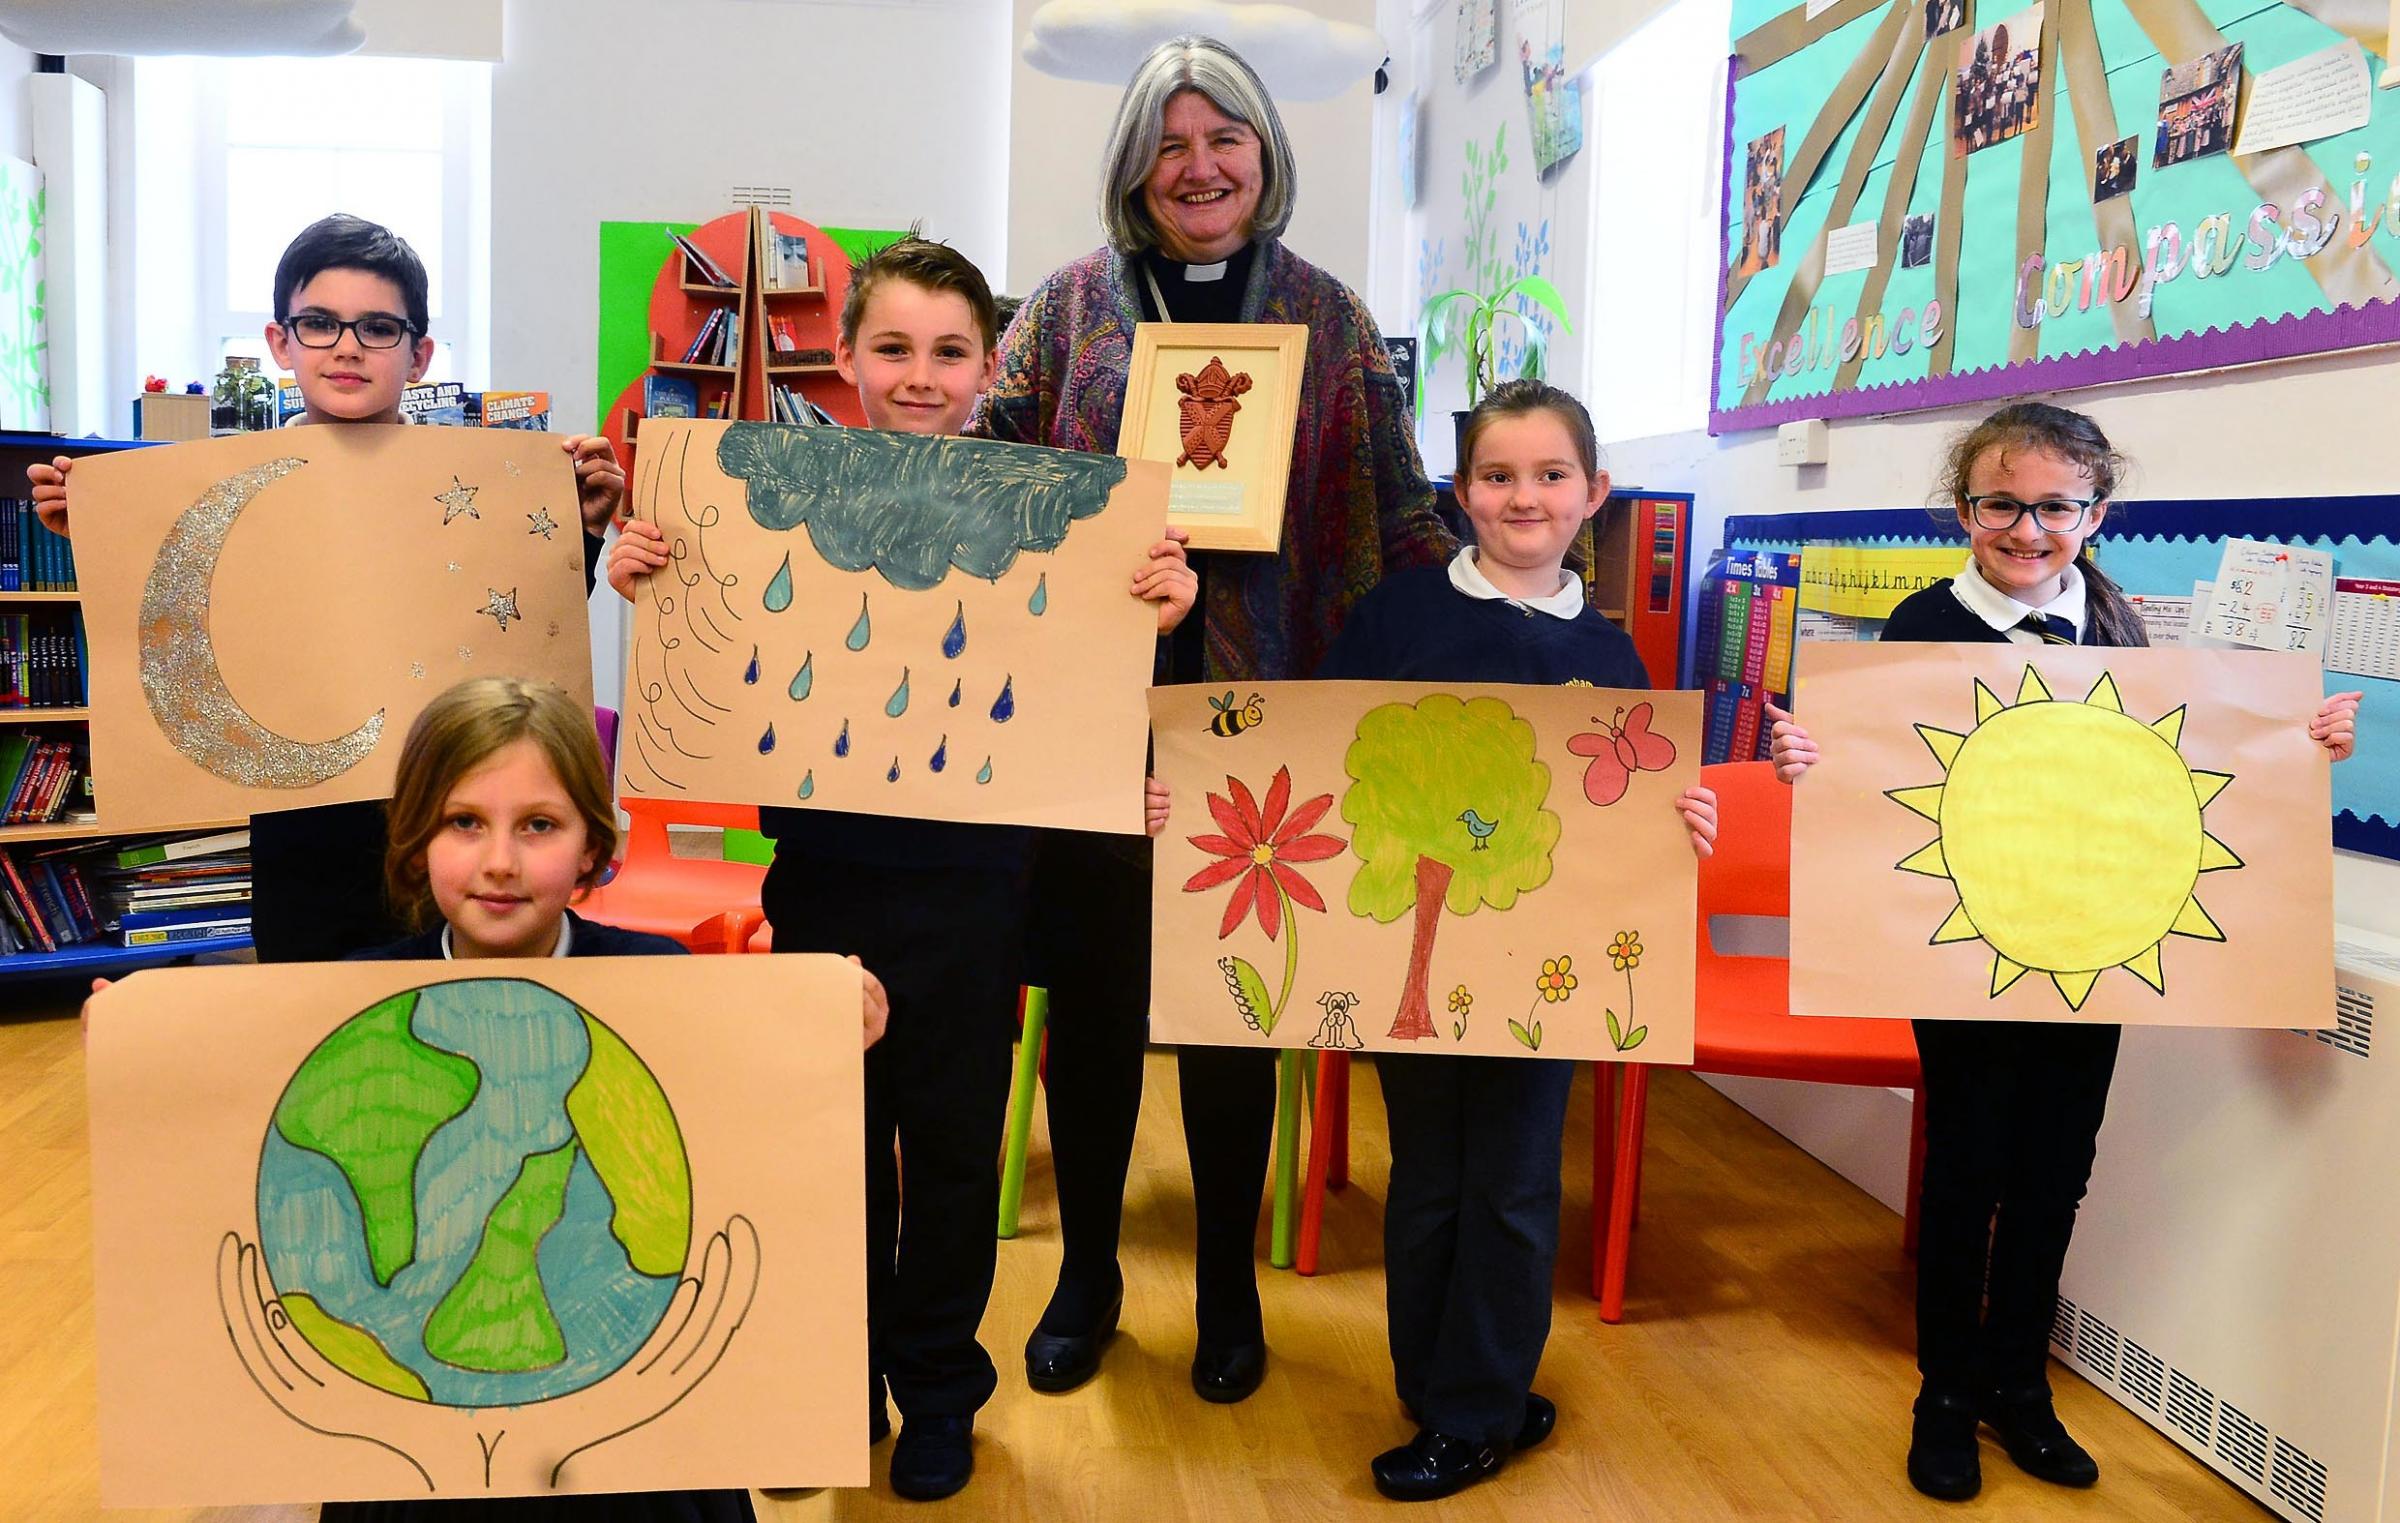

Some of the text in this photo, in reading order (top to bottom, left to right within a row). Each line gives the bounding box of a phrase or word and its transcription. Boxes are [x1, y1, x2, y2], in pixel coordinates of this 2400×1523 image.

[1737, 298, 1944, 388] Excellence
[402, 384, 461, 401] ASTE AND
[400, 396, 456, 412] ECYCLING
[487, 396, 535, 411] CLIMATE
[486, 408, 531, 423] CHANGE
[1725, 556, 1779, 580] Times Tables
[2223, 620, 2245, 637] 38
[1741, 685, 1750, 697] 7x
